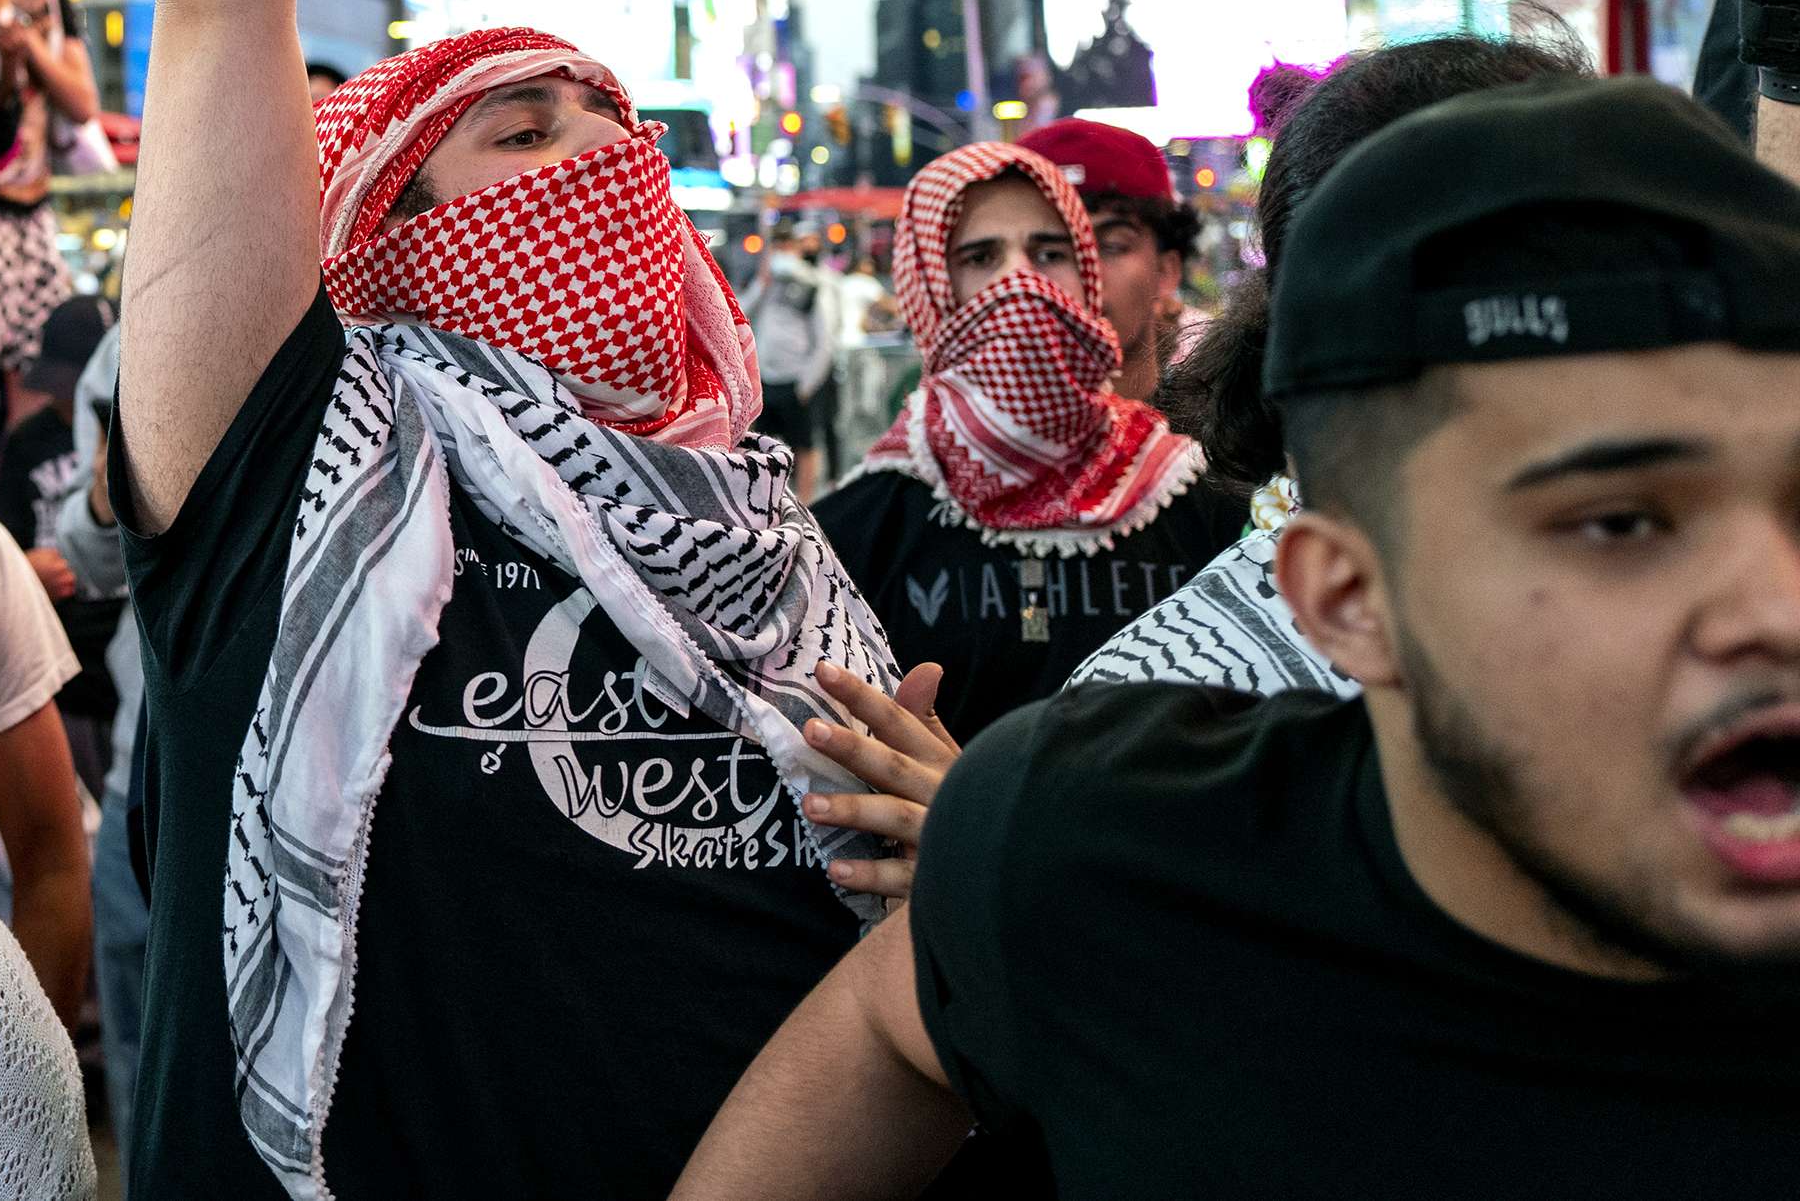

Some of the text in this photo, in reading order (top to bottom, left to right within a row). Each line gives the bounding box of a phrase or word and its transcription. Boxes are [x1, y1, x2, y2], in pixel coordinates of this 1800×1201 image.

[495, 561, 541, 590] 1971
[462, 655, 668, 735] east
[553, 737, 765, 820] west
